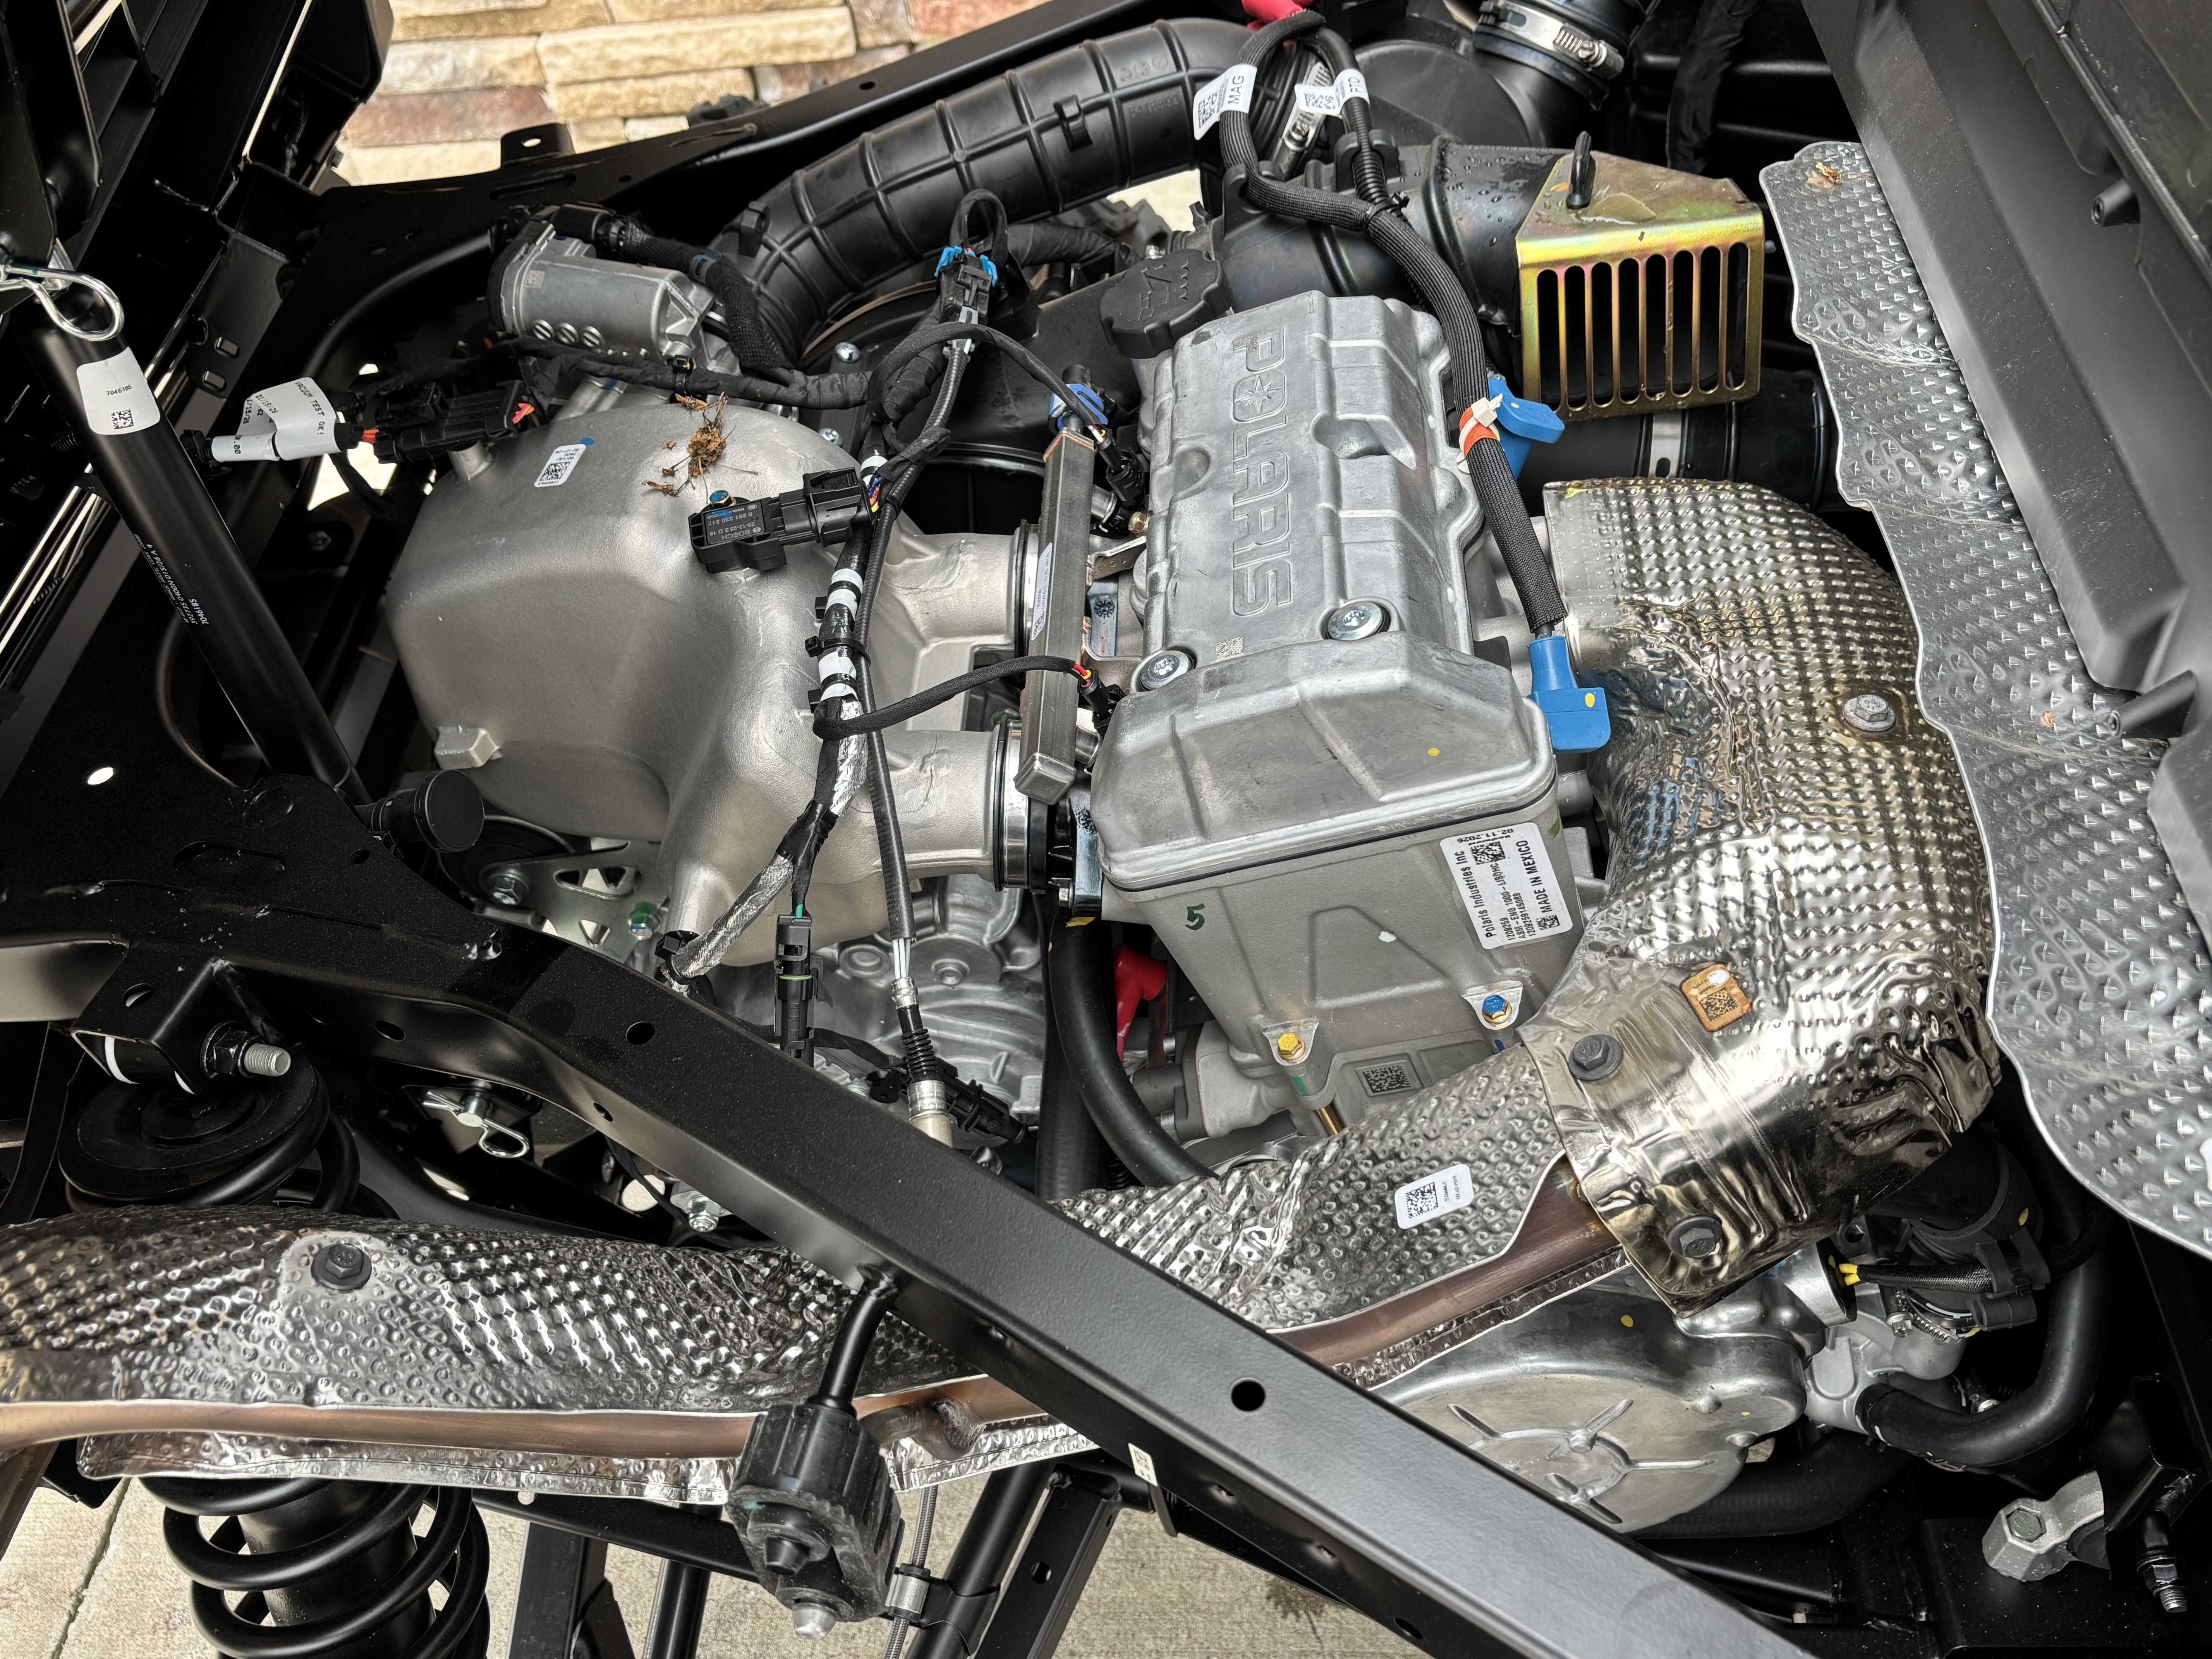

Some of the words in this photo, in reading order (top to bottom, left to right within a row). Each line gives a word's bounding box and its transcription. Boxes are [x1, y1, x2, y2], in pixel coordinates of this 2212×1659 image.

[1228, 75, 1244, 105] MAG
[295, 381, 313, 398] VACUUM
[311, 400, 325, 416] TEST
[317, 421, 325, 435] OK!
[1232, 326, 1291, 617] POLARIS
[722, 529, 750, 540] BOSCH
[189, 599, 210, 625] 7046185
[1457, 828, 1514, 843] 02.11.2026
[1455, 851, 1467, 864] Inc
[1516, 840, 1538, 874] MEXICO
[1461, 866, 1485, 908] Industries
[1529, 876, 1543, 886] IN
[1534, 888, 1553, 913] MADE
[1185, 902, 1206, 931] 5
[1478, 910, 1497, 938] Polaris
